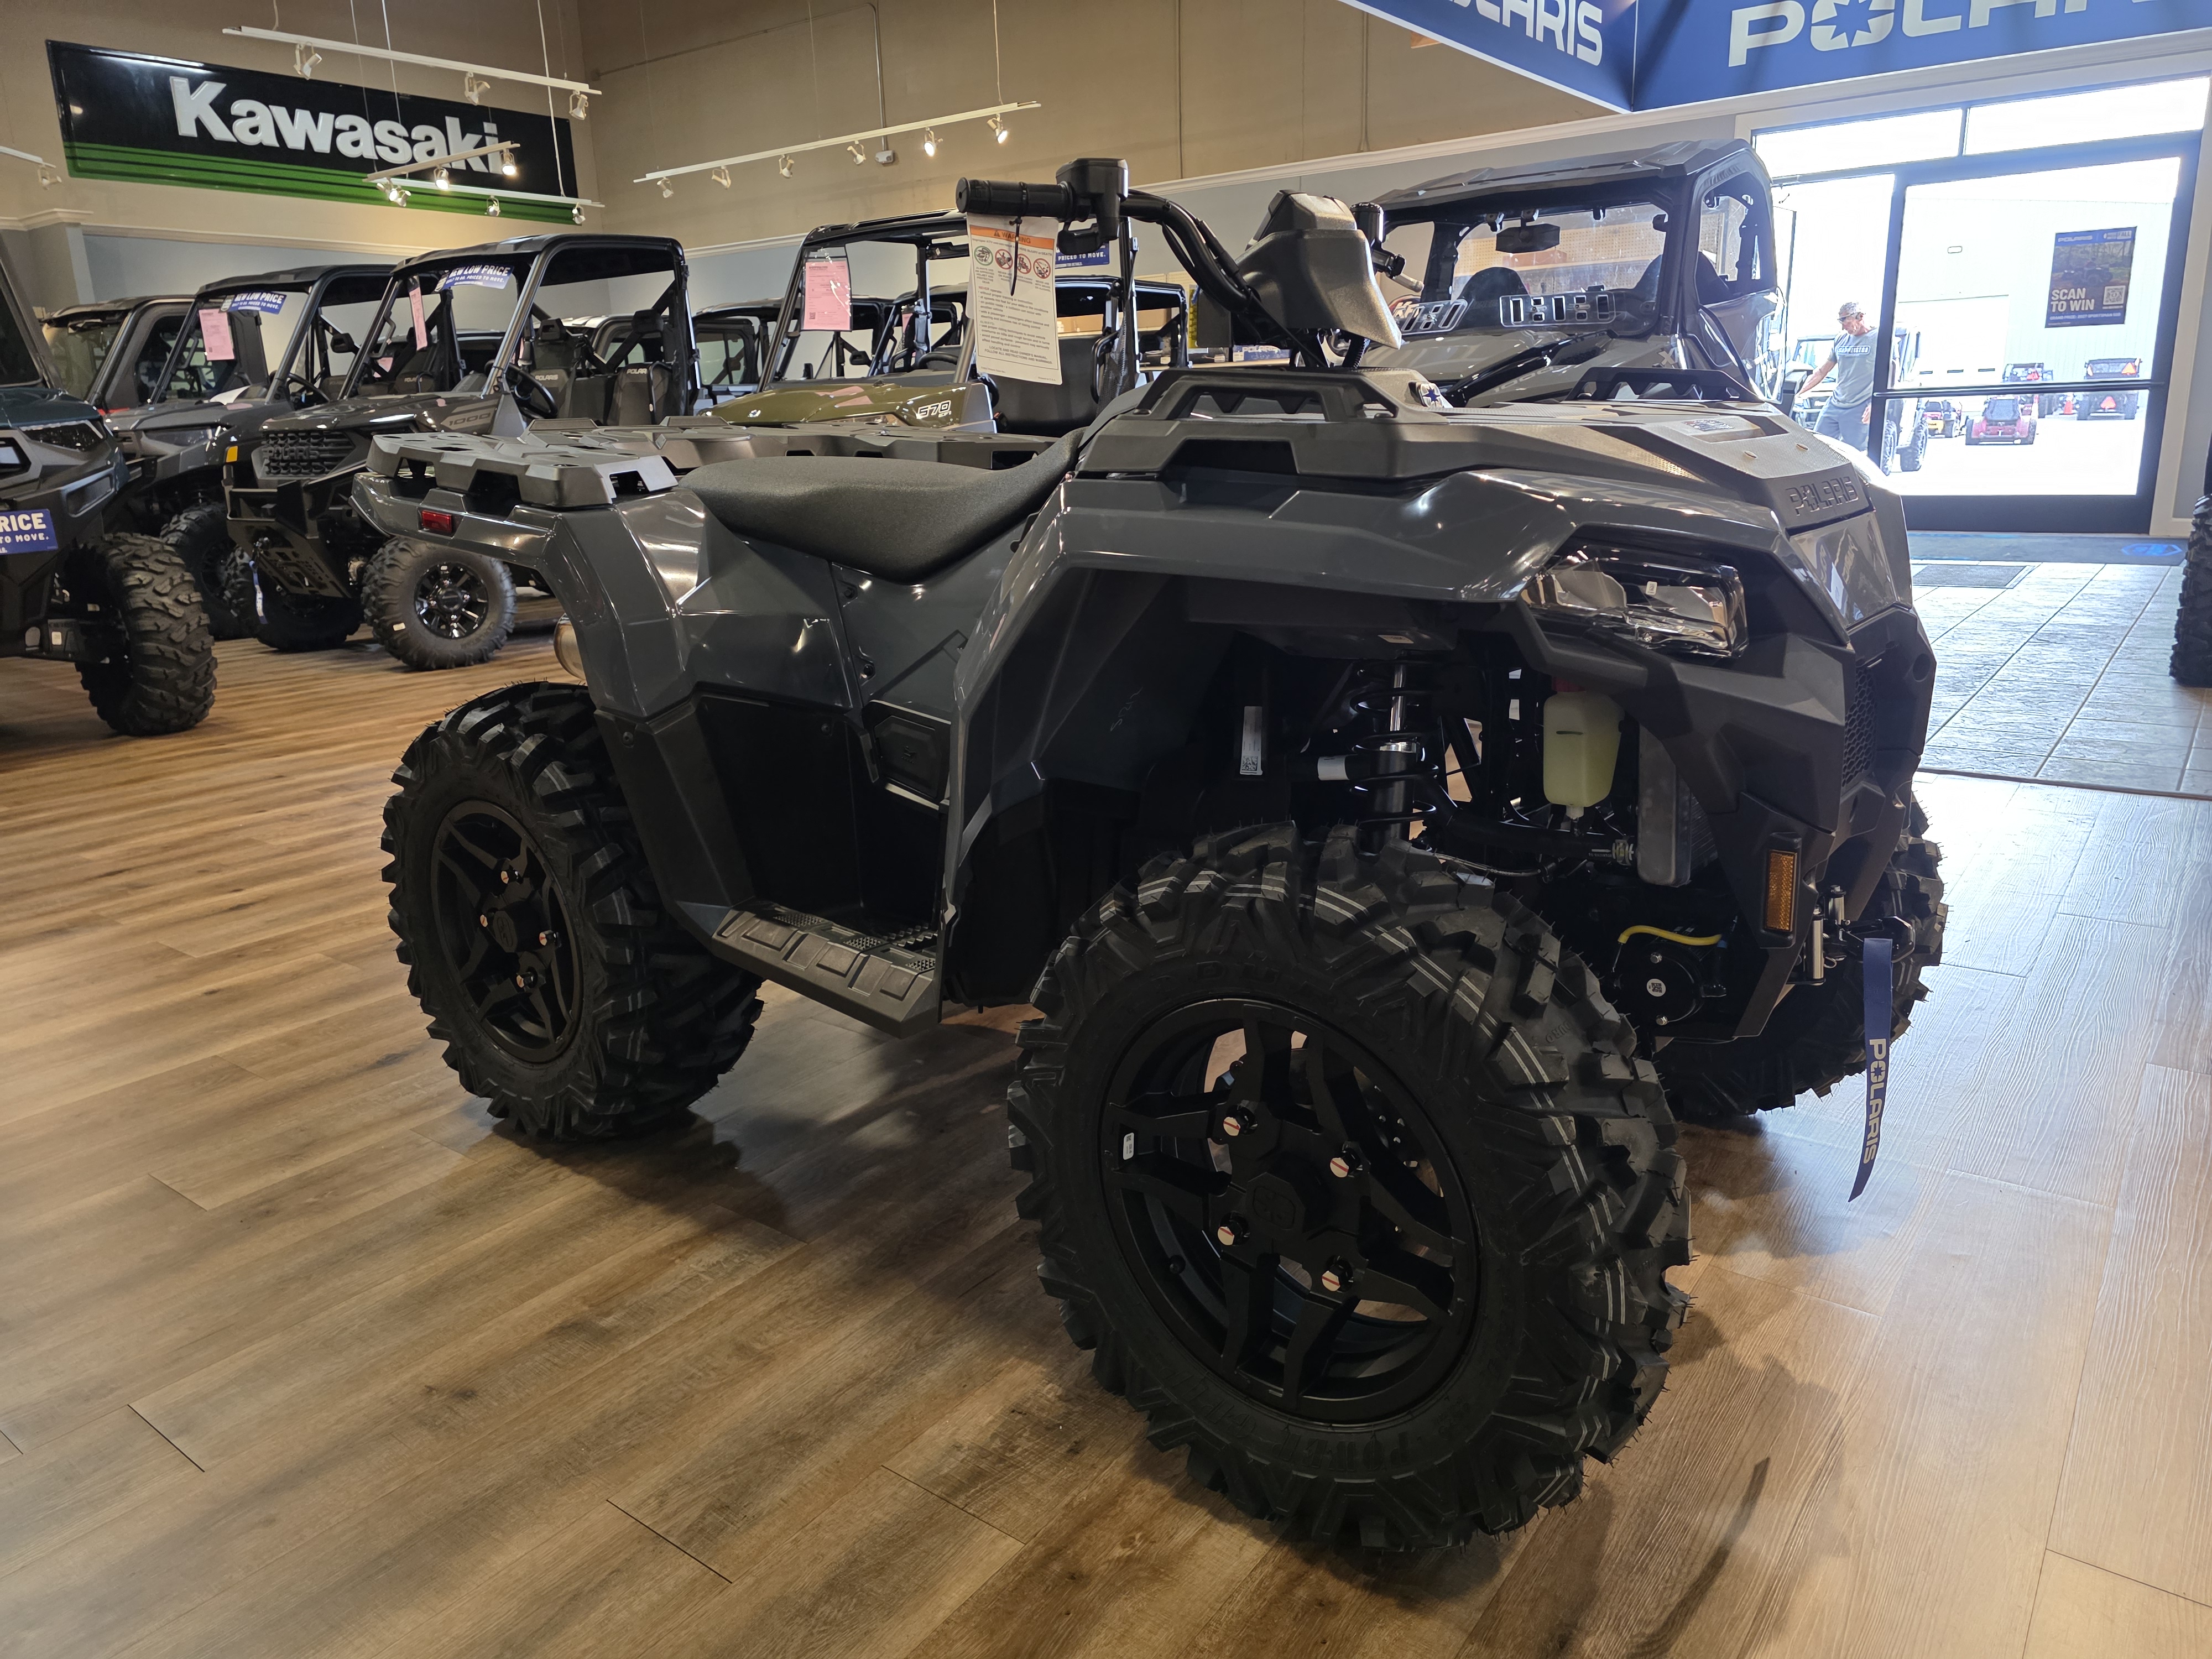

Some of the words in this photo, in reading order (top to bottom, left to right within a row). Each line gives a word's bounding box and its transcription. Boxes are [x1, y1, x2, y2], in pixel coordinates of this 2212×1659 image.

[169, 76, 501, 174] Kawasaki
[449, 267, 466, 278] NEW
[463, 265, 482, 274] LOW
[481, 265, 510, 276] PRICE
[260, 293, 284, 304] PRICE
[2051, 288, 2086, 300] SCAN
[2051, 300, 2067, 312] TO
[2069, 299, 2095, 311] WIN
[917, 400, 951, 419] 570
[449, 412, 491, 426] 1000
[262, 444, 319, 460] POLARIS
[1786, 476, 1859, 517] POLARIS
[15, 533, 49, 542] MOVE.
[1863, 1038, 1886, 1164] POLARIS
